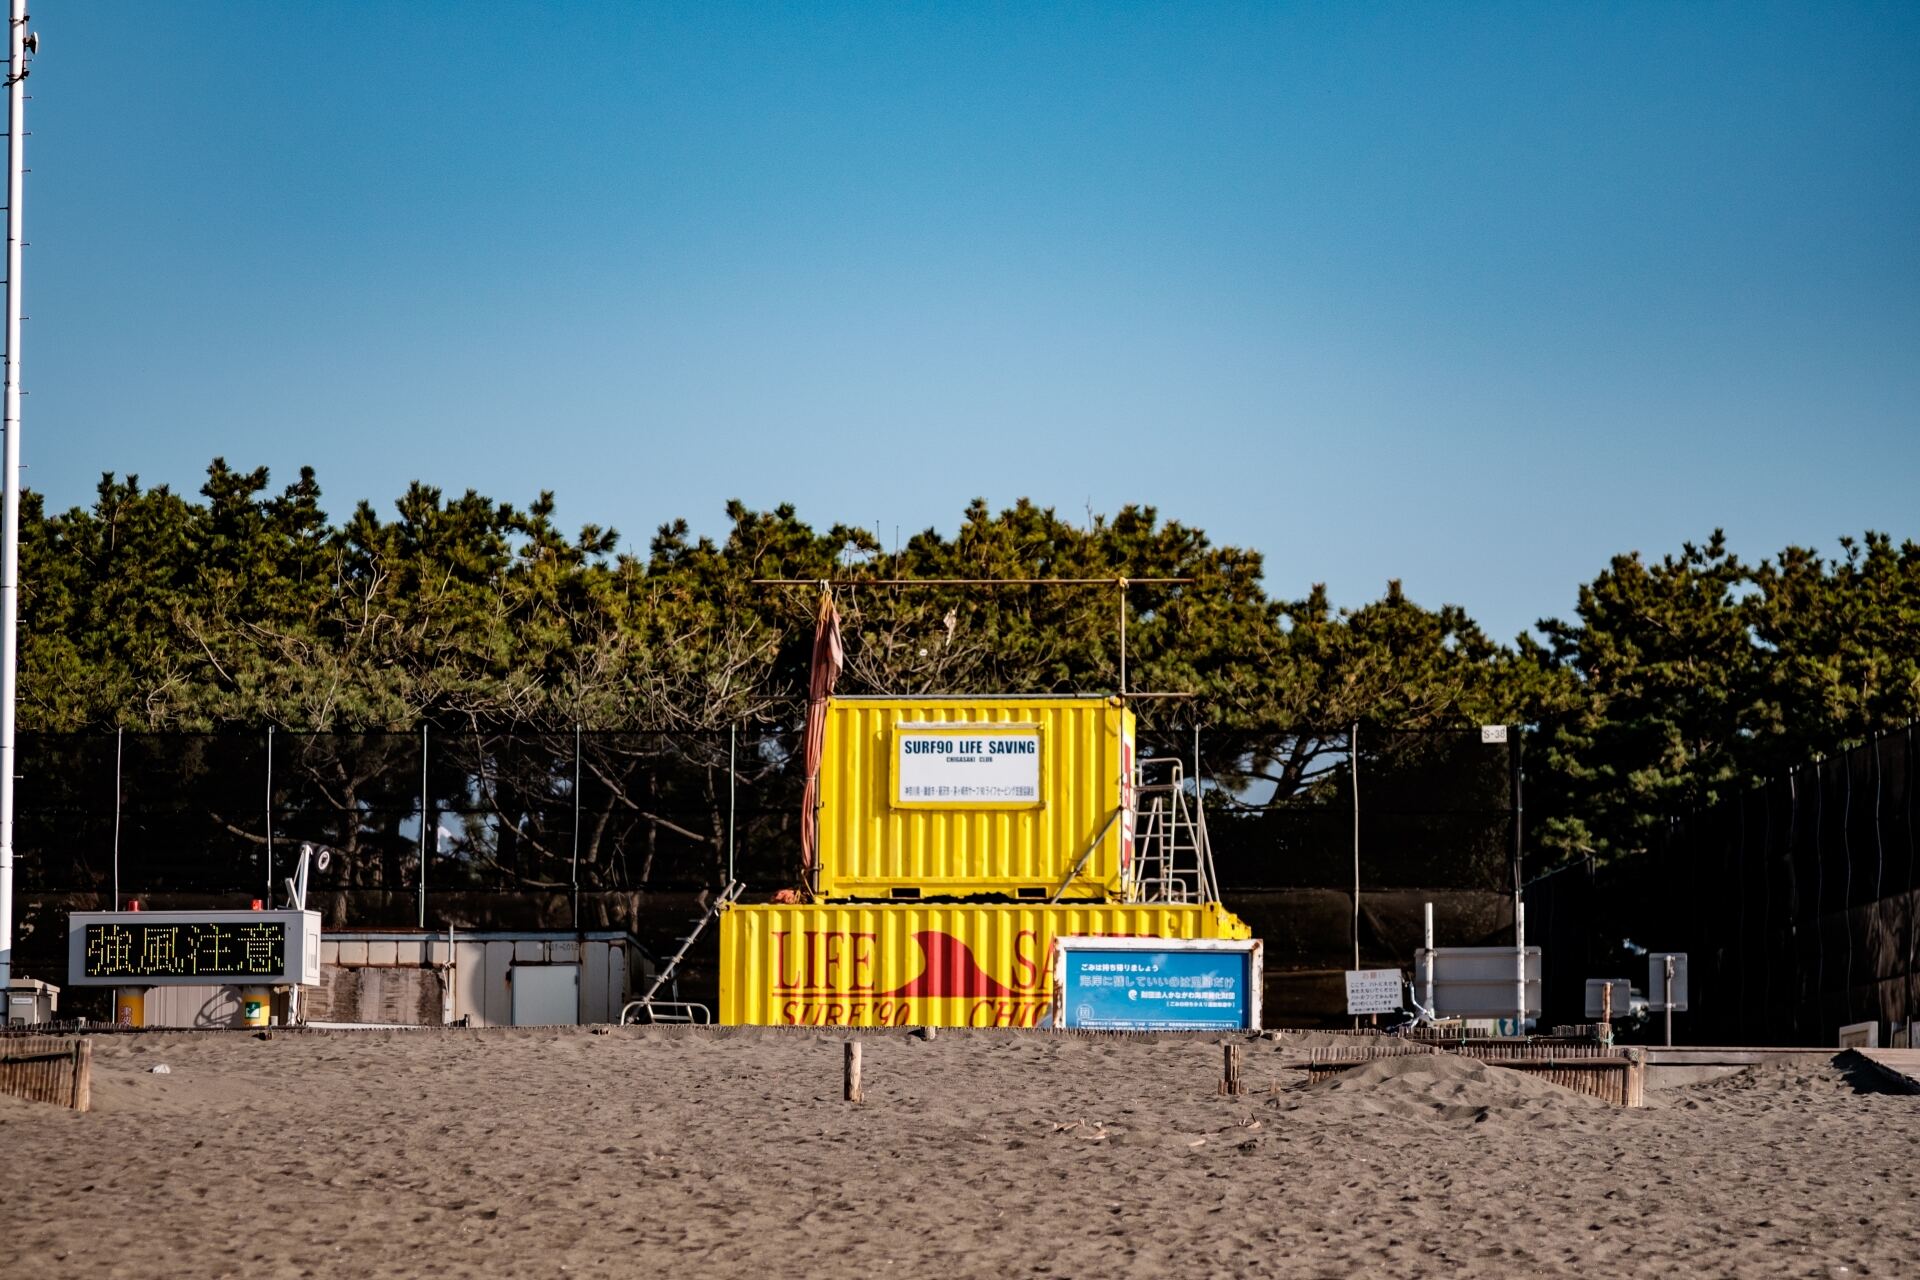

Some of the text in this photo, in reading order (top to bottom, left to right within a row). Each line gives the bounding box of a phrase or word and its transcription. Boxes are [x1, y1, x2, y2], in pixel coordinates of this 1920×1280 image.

[904, 741, 1035, 754] SURF90 LIFE SAVING
[87, 922, 285, 975] 強風注意
[771, 931, 877, 990] LIFE
[1080, 963, 1159, 972] ごみは持ち帰りましょう
